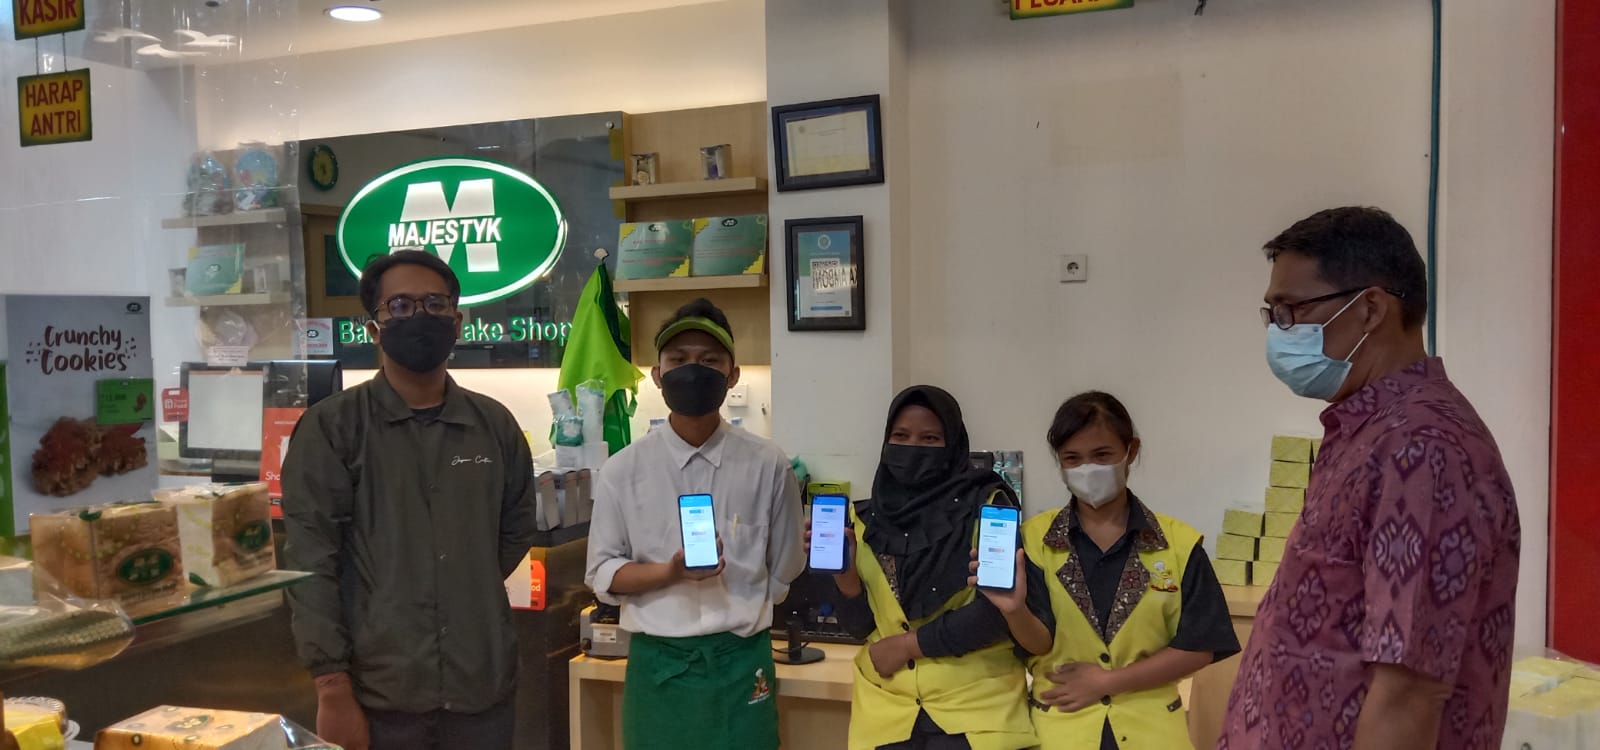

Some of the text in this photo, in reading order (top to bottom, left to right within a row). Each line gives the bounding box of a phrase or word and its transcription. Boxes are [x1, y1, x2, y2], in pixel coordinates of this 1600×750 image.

[19, 0, 77, 26] KASIR
[25, 79, 84, 108] HARAP
[30, 109, 82, 137] ANTRI
[388, 217, 503, 248] MAJESTYK
[43, 325, 123, 351] Crunchy
[463, 316, 504, 342] ake
[510, 315, 573, 346] Shop
[40, 347, 128, 376] Cookies
